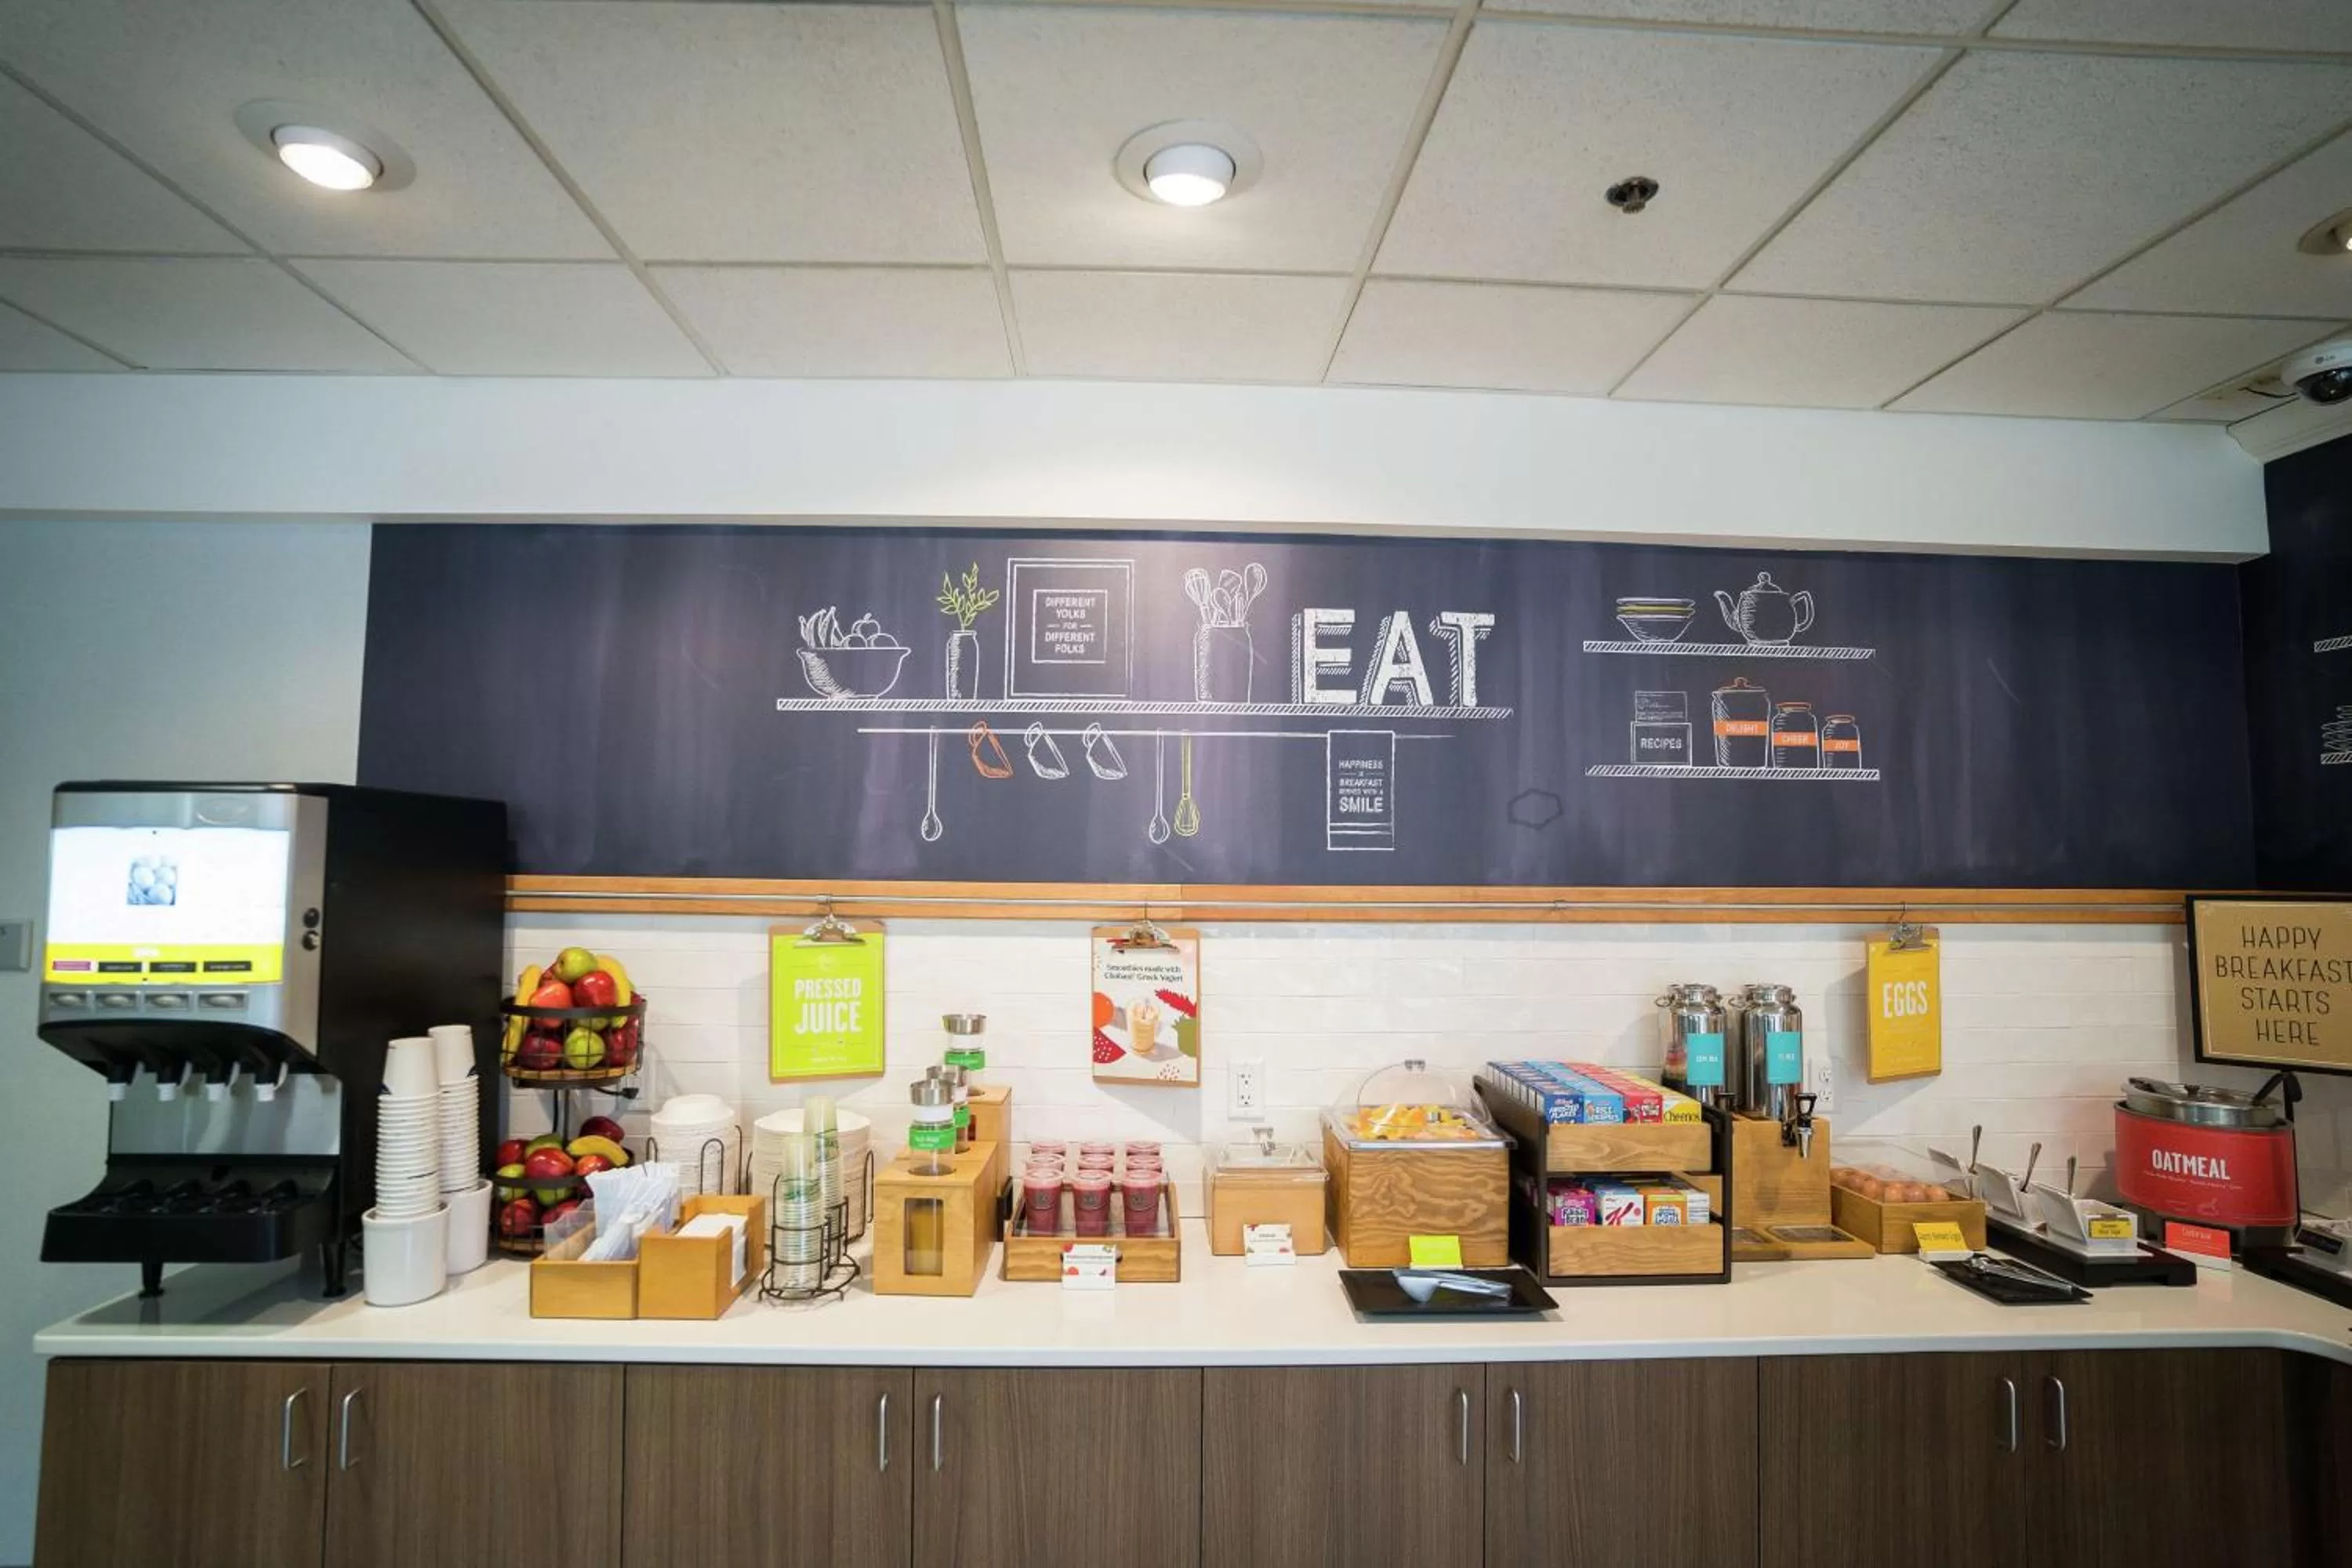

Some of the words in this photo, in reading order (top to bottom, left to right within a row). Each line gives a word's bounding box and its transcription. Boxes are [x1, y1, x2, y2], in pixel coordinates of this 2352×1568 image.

[1045, 597, 1096, 608] DIFFERENT
[1056, 608, 1086, 619] YOLKS
[1044, 632, 1095, 642] DIFFERENT
[1054, 643, 1085, 654] FOLKS
[1293, 608, 1495, 707] EAT
[1726, 724, 1758, 733] DELIGHT
[1639, 738, 1682, 750] RECIPES
[1834, 741, 1849, 750] JOY
[1338, 759, 1384, 769] HAPPINESS
[1338, 778, 1384, 786] BREAKFAST
[1338, 796, 1384, 813] SMILE
[2241, 924, 2321, 950] HAPPY
[2215, 954, 2352, 983] BREAKFAST
[794, 978, 862, 1000] PRESSED
[1882, 981, 1929, 1018] EGGS
[2241, 987, 2330, 1014] STARTS
[793, 1001, 862, 1035] JUICE
[2256, 1018, 2320, 1046] HERE
[1664, 1110, 1700, 1123] Cheerios
[2152, 1149, 2230, 1180] OATMEAL
